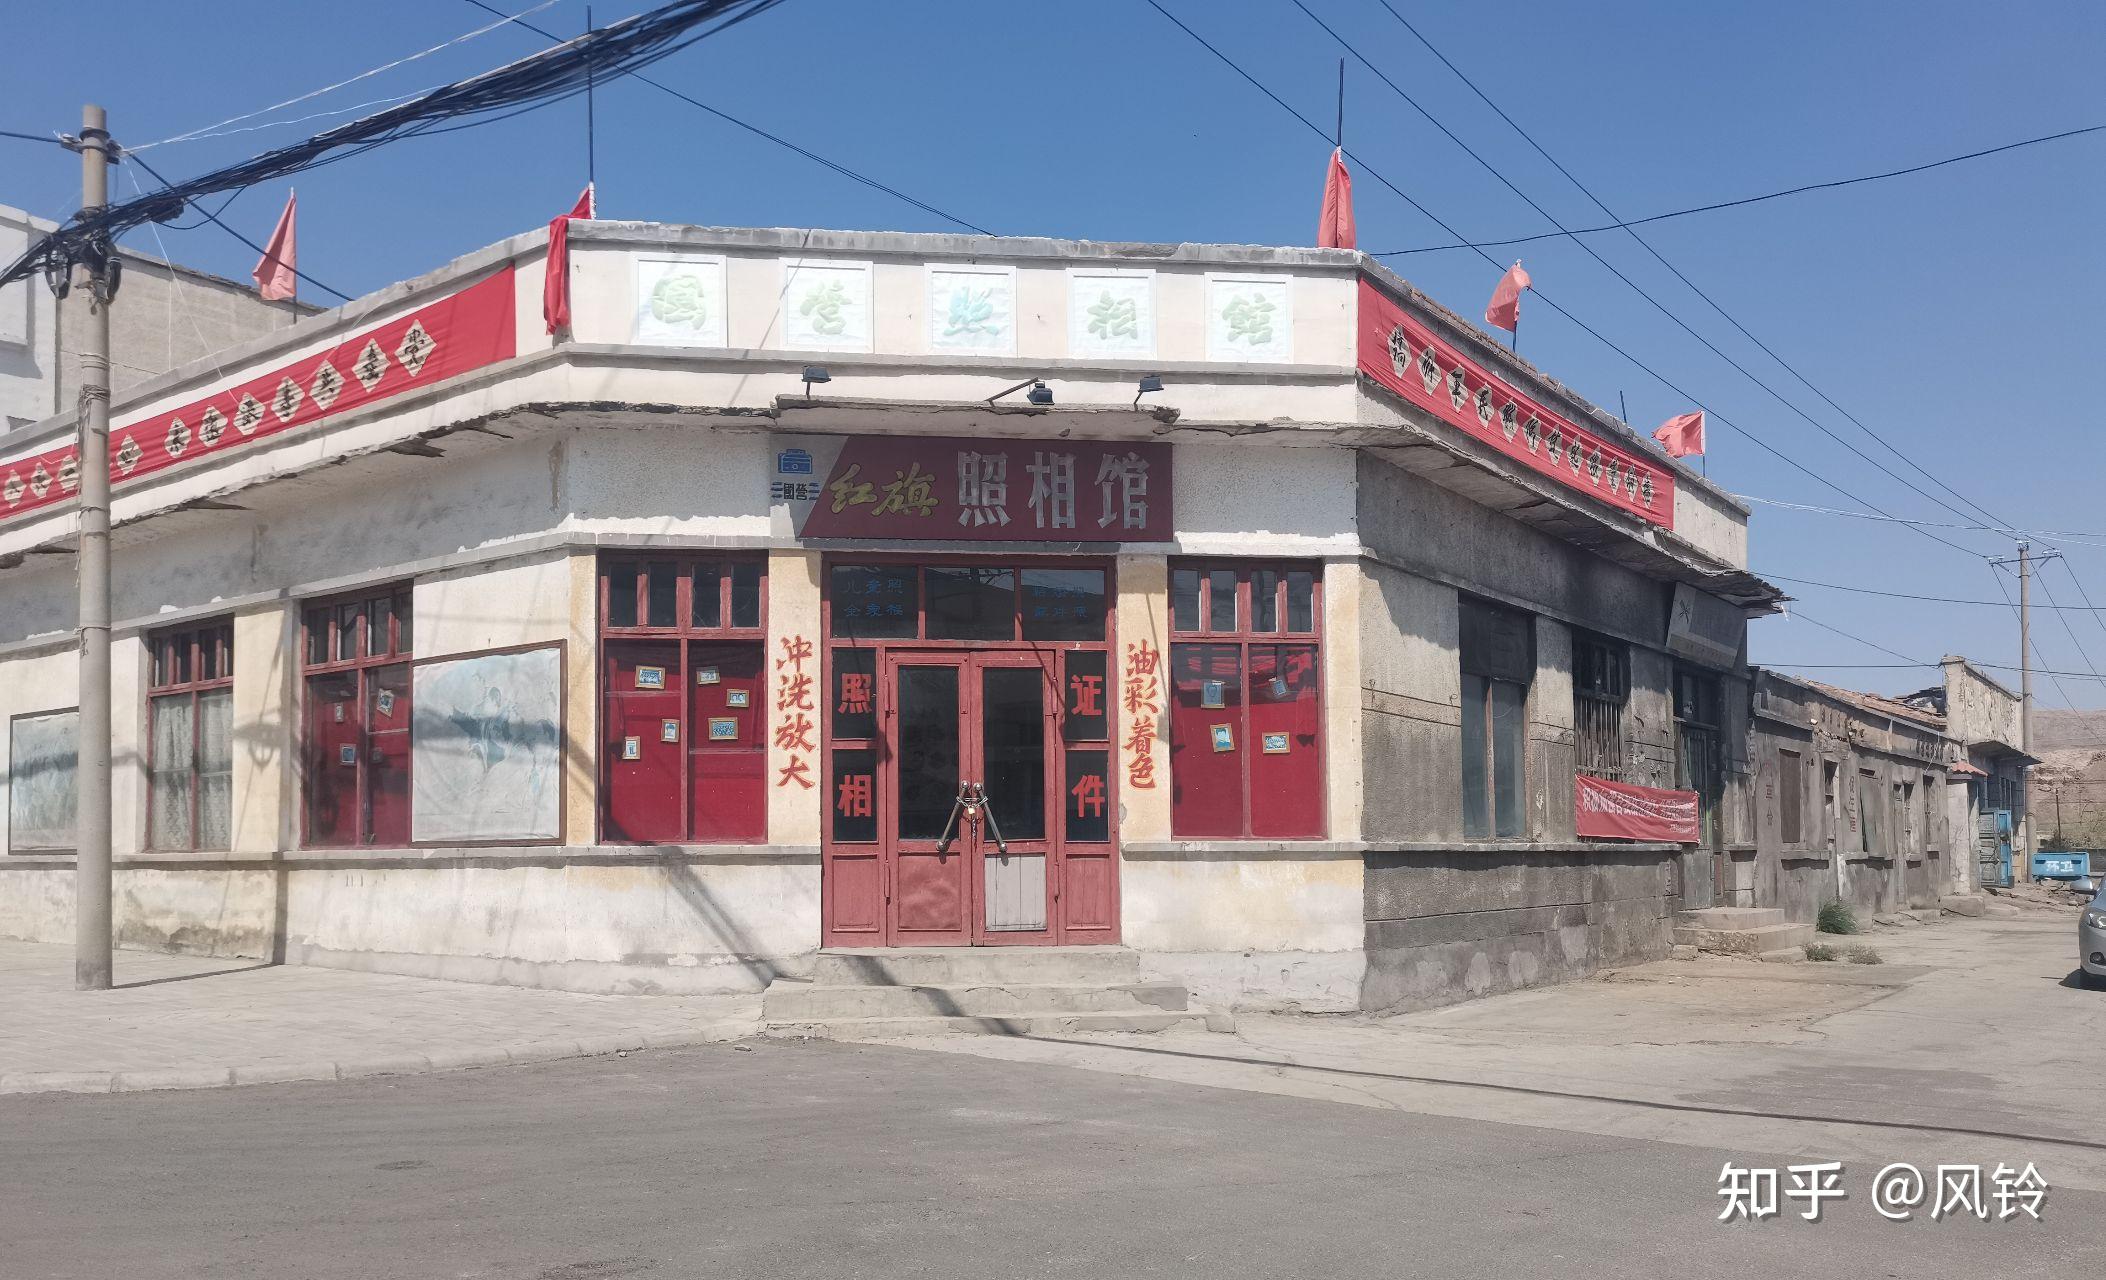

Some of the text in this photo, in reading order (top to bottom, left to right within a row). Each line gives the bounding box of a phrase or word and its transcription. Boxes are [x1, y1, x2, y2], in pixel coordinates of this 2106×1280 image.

[829, 450, 1150, 531] 红旗 照相馆
[774, 634, 816, 790] 冲洗放大
[838, 673, 872, 817] 照相
[1070, 675, 1105, 818] 证件
[1122, 638, 1159, 790] 油彩着色
